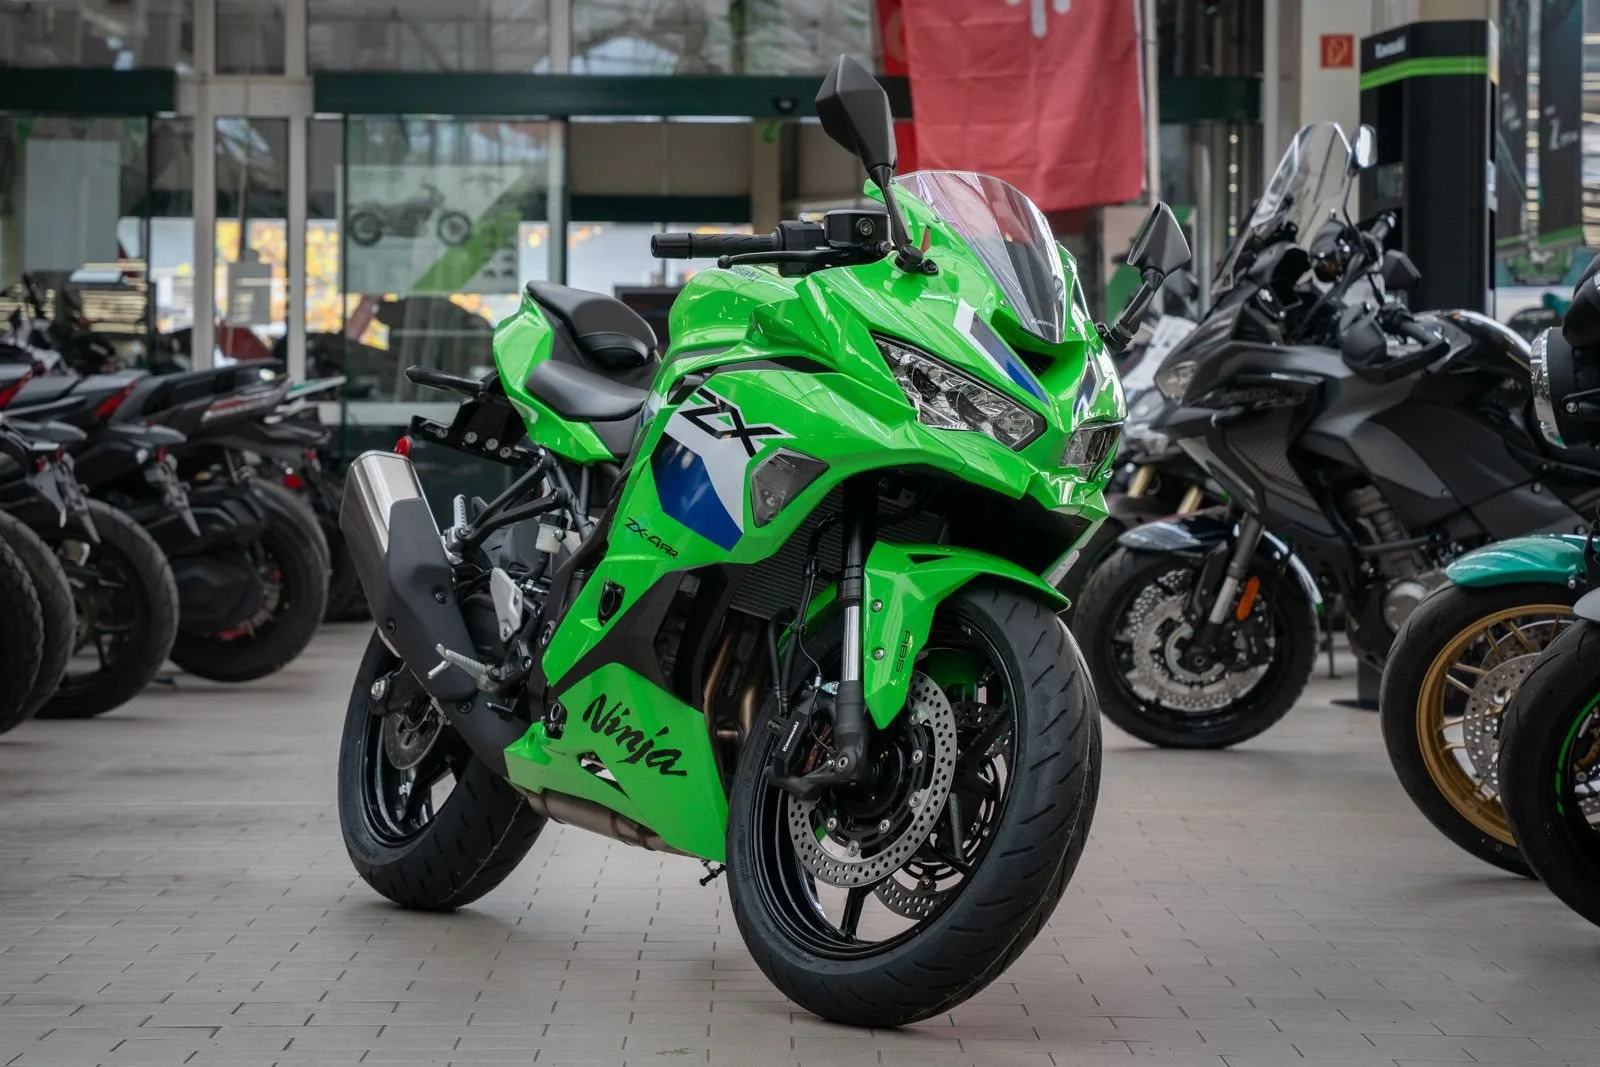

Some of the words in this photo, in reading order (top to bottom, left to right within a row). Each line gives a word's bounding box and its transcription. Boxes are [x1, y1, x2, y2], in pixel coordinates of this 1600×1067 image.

[678, 387, 783, 459] ZX
[624, 517, 679, 560] ZX-4RR
[895, 630, 911, 673] ABS
[582, 693, 688, 777] Ninja
